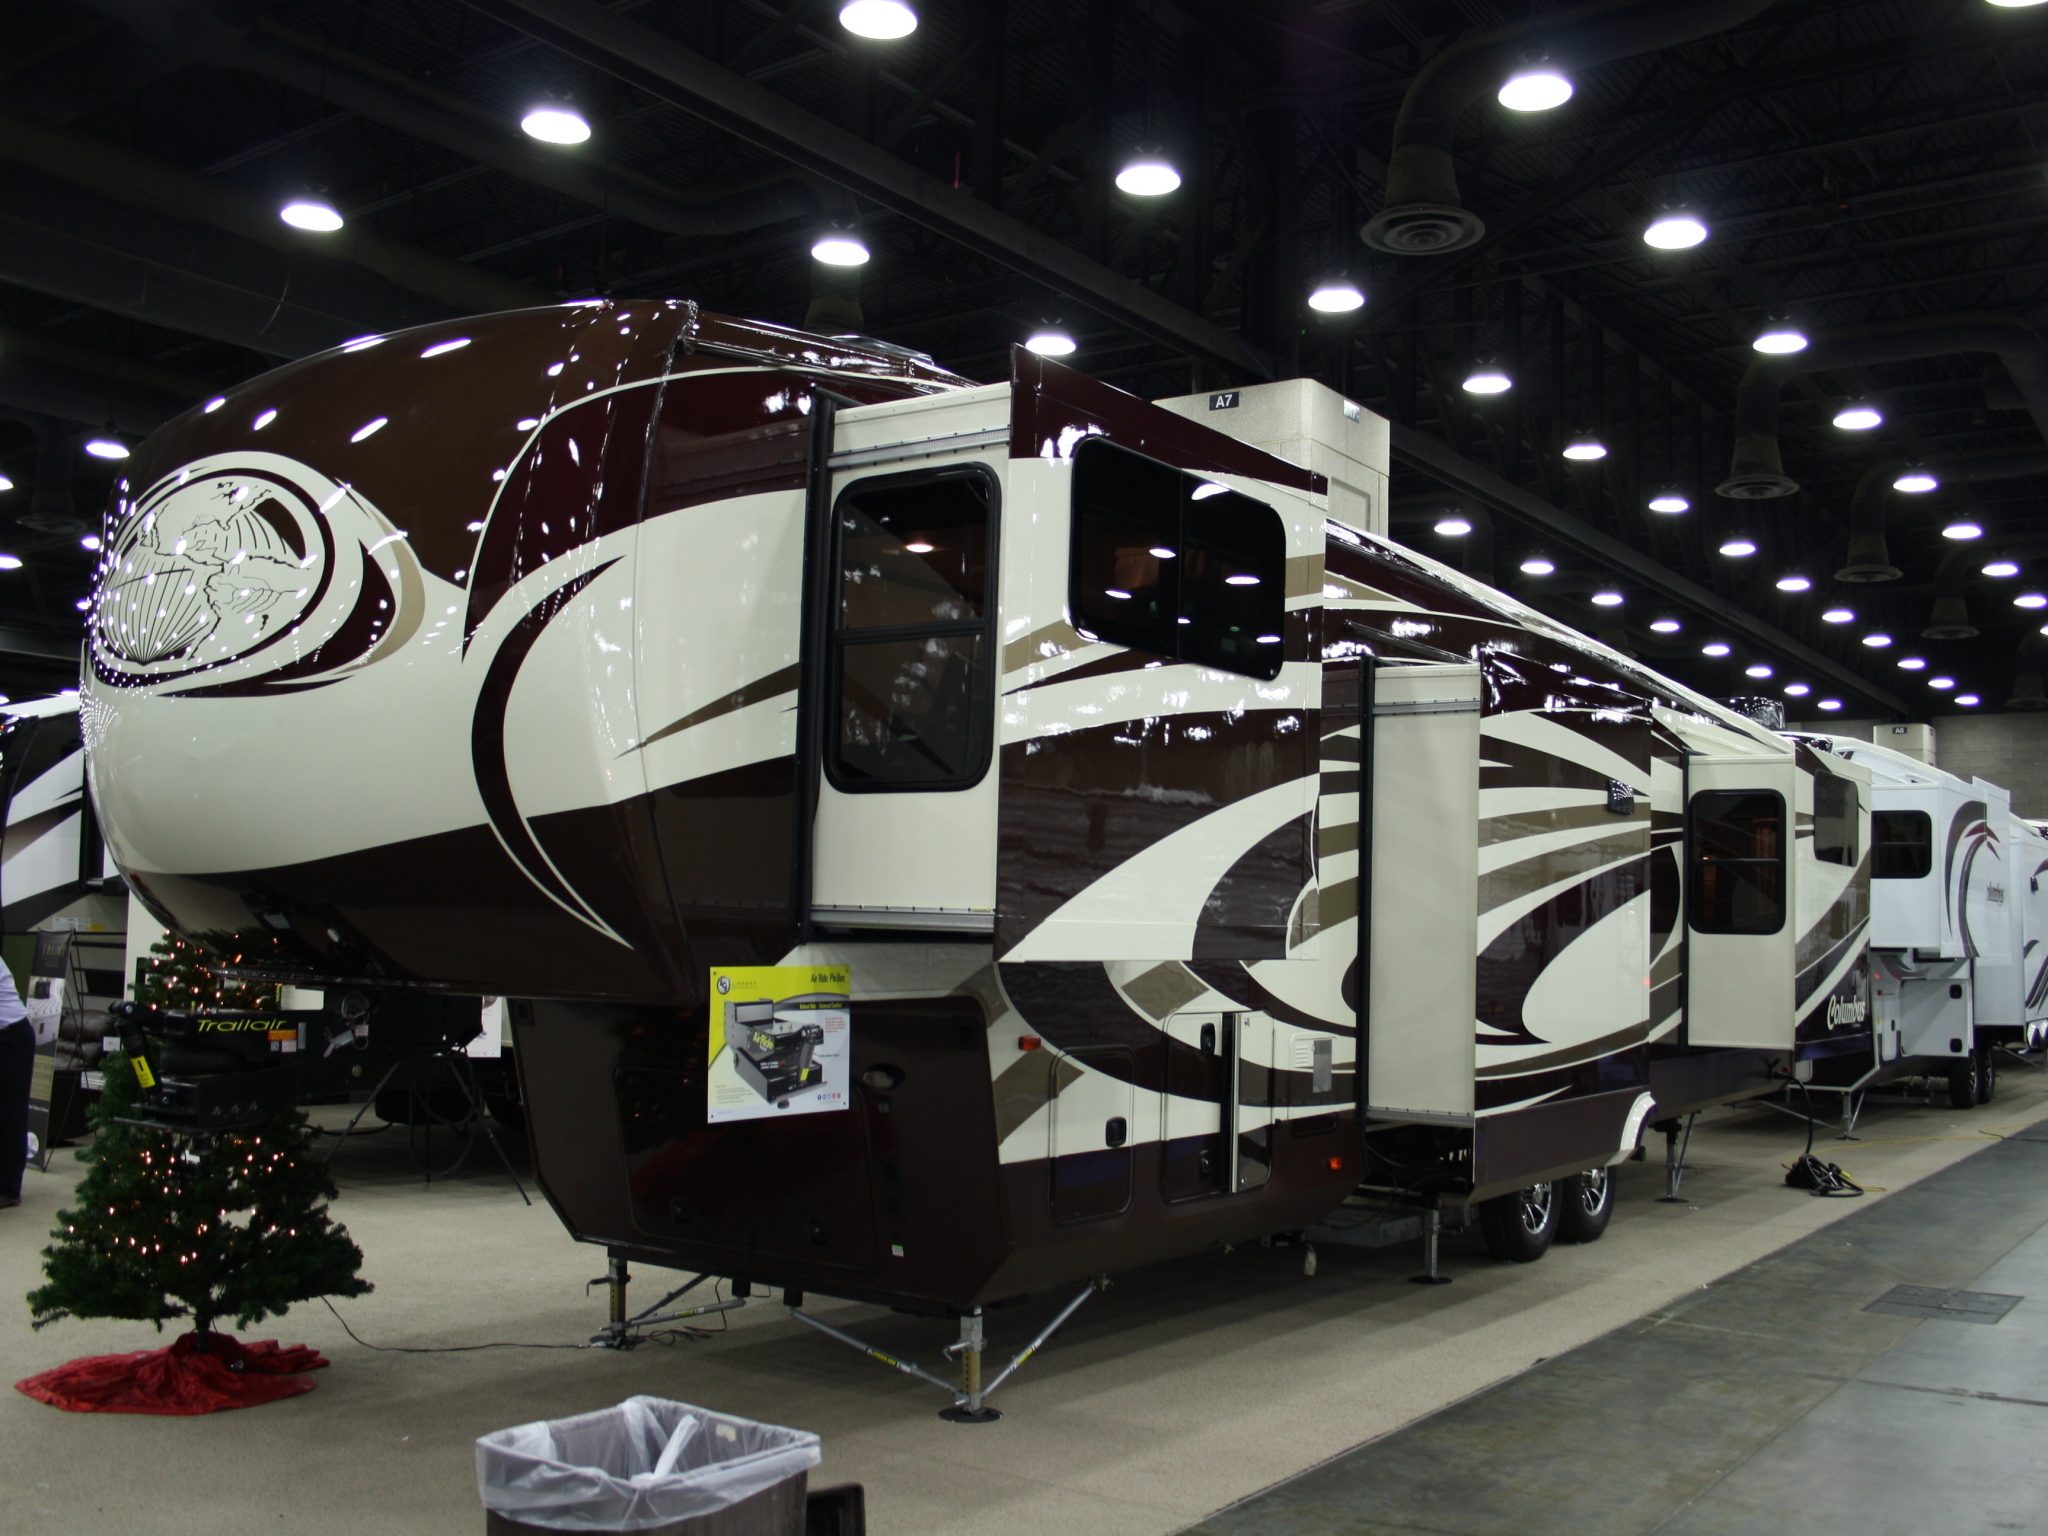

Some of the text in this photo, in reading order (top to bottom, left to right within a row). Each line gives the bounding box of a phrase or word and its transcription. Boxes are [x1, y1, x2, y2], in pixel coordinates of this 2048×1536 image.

[1215, 394, 1233, 409] A7
[810, 973, 818, 983] Air
[1827, 994, 1865, 1031] Columbus
[197, 1018, 287, 1033] Trailair
